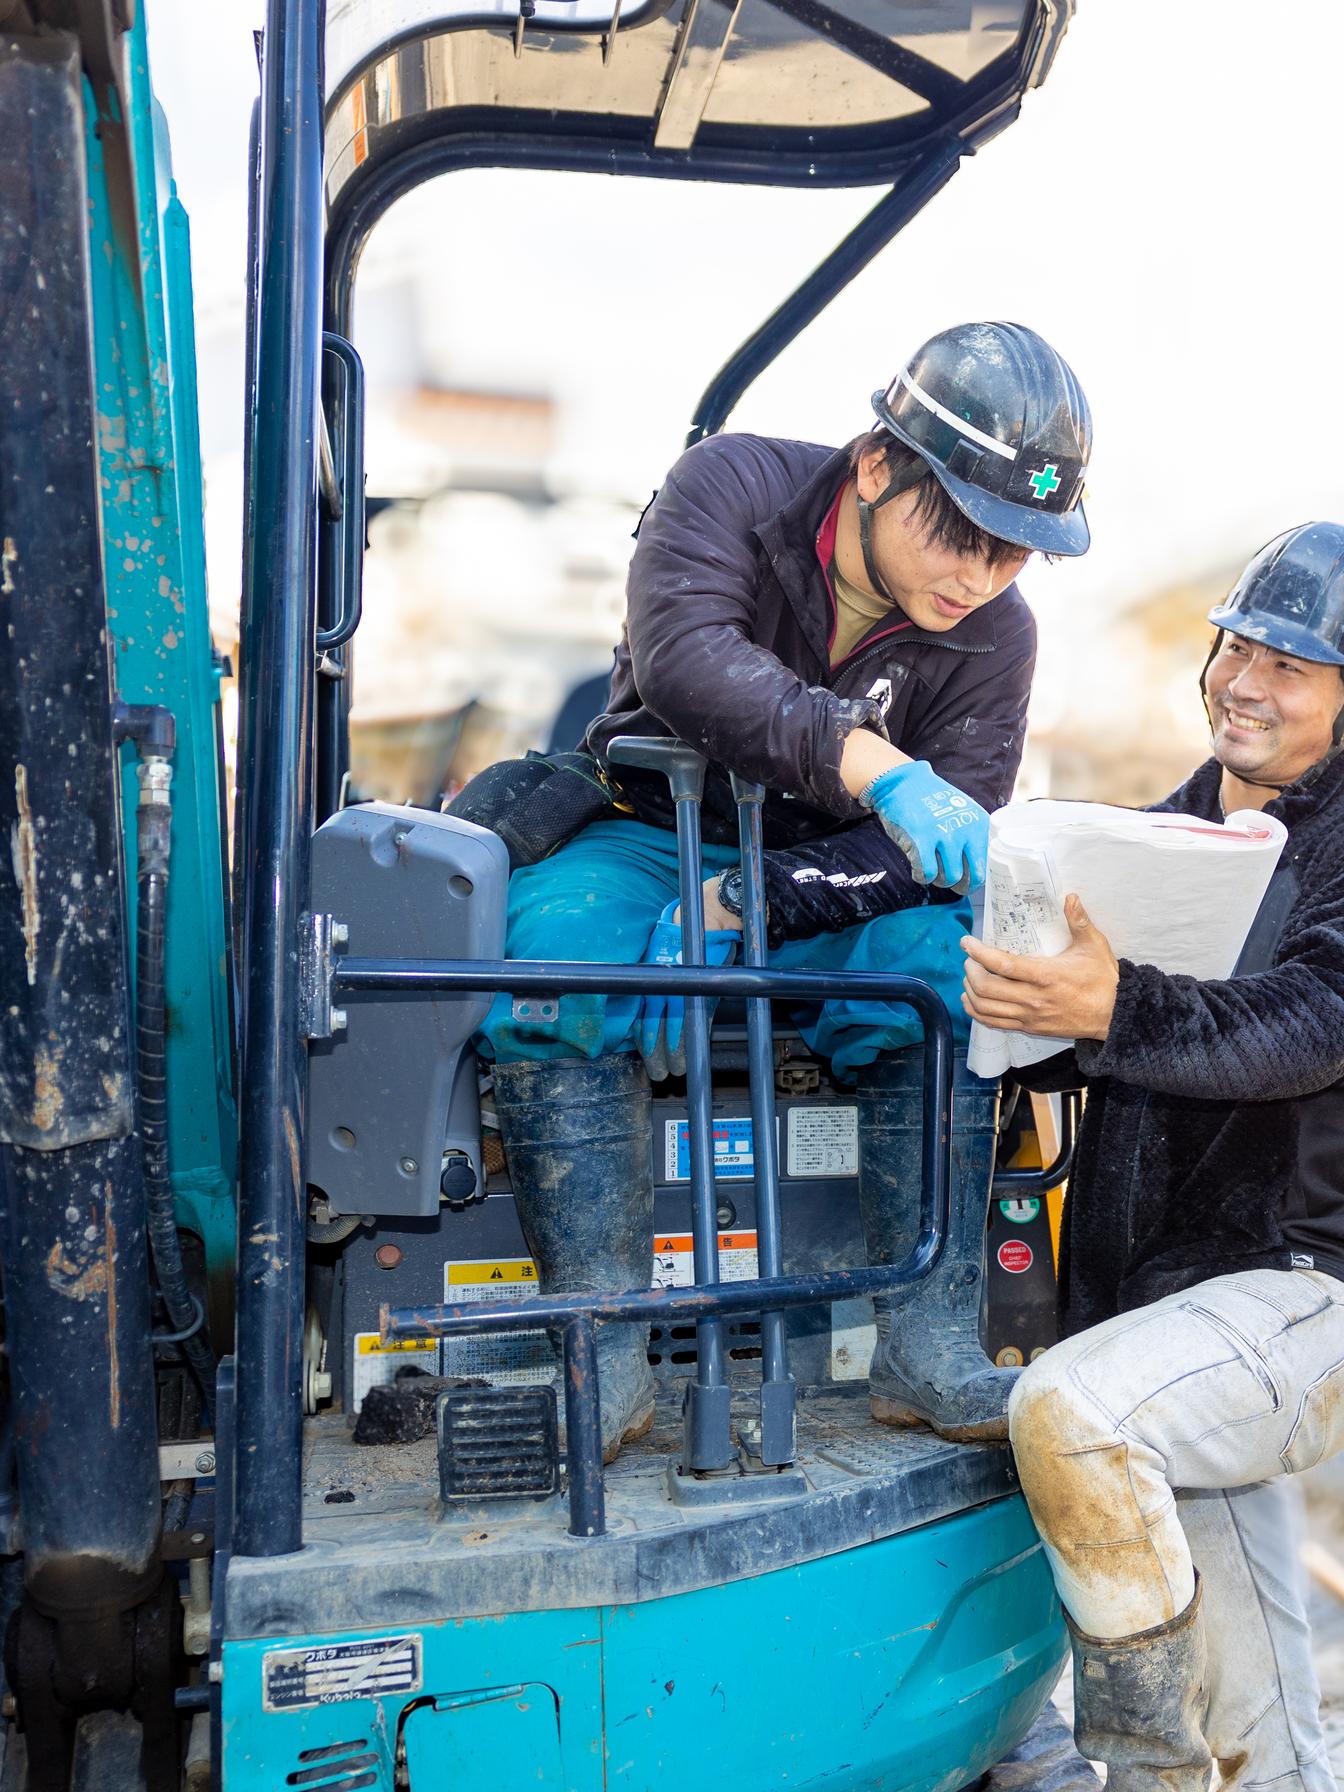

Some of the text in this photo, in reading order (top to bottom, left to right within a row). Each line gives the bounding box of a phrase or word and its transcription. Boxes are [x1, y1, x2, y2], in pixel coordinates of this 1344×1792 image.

[936, 810, 979, 834] AQUA
[304, 1649, 338, 1663] クボタ
[319, 1691, 362, 1704] Kubota
